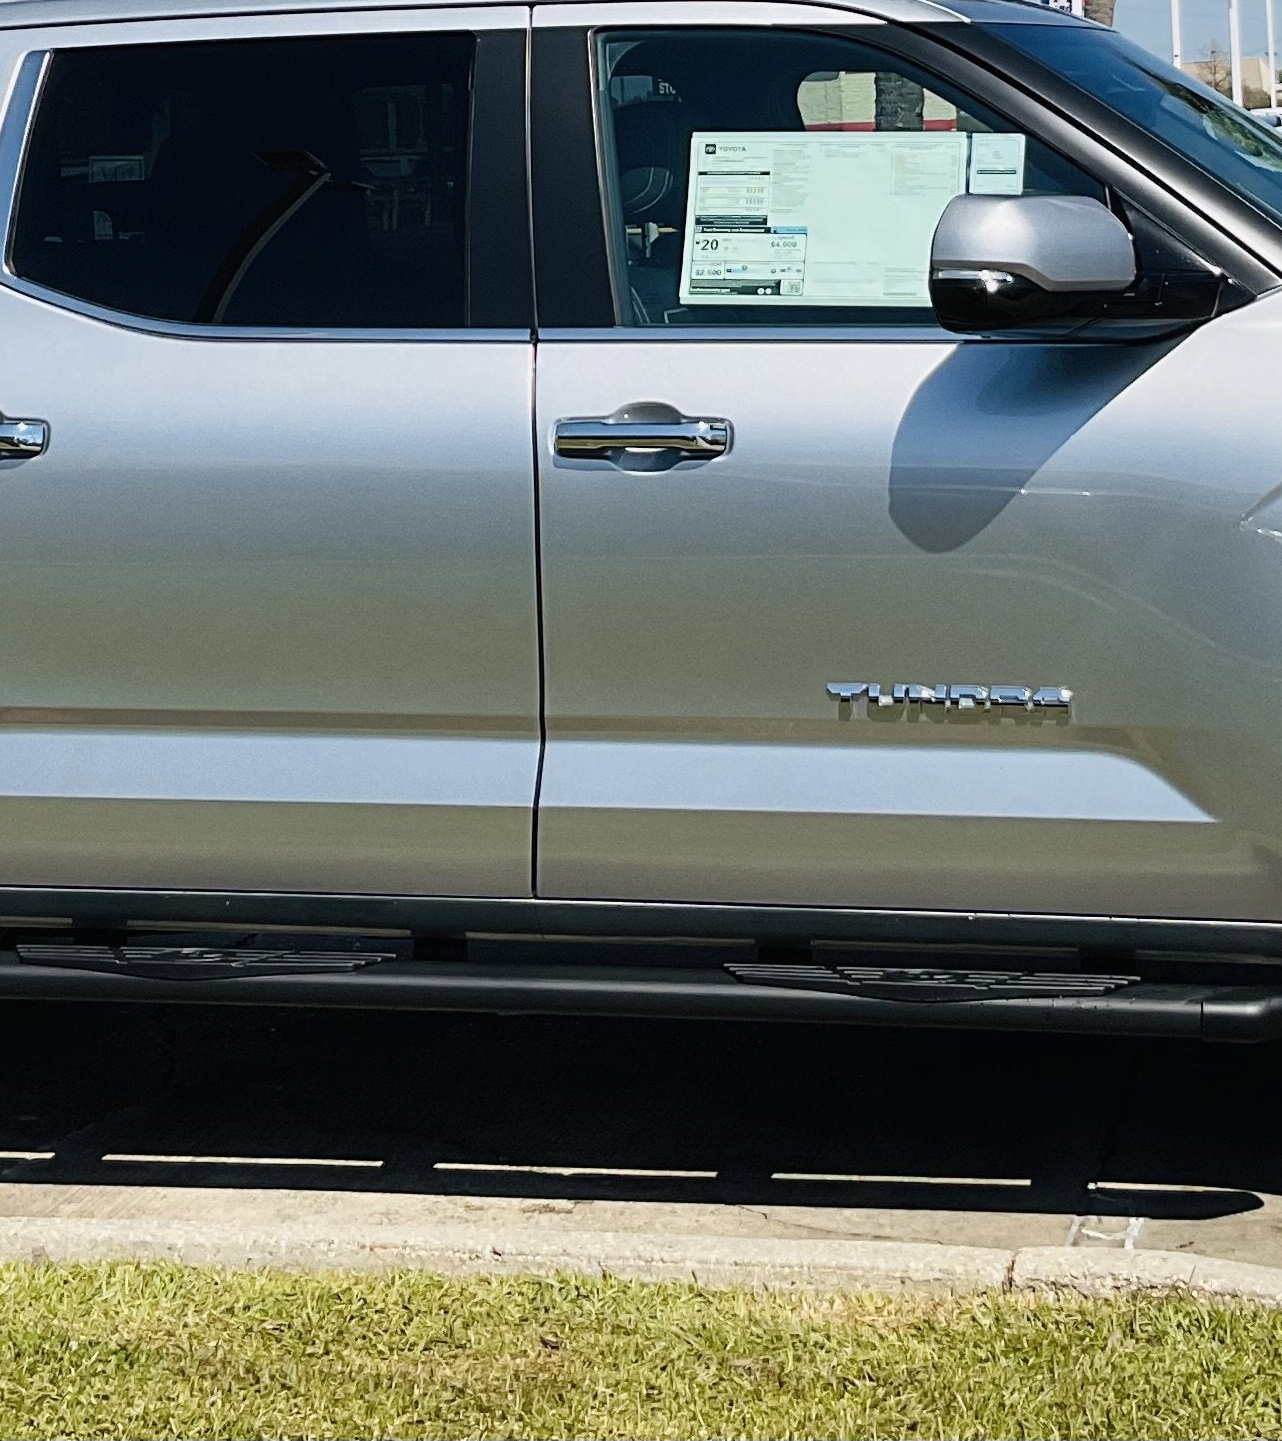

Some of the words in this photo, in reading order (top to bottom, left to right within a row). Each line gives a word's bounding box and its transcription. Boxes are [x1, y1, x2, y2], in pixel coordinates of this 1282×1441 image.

[659, 82, 677, 95] ST
[700, 239, 719, 251] 20
[826, 681, 1075, 725] TUNDRA
